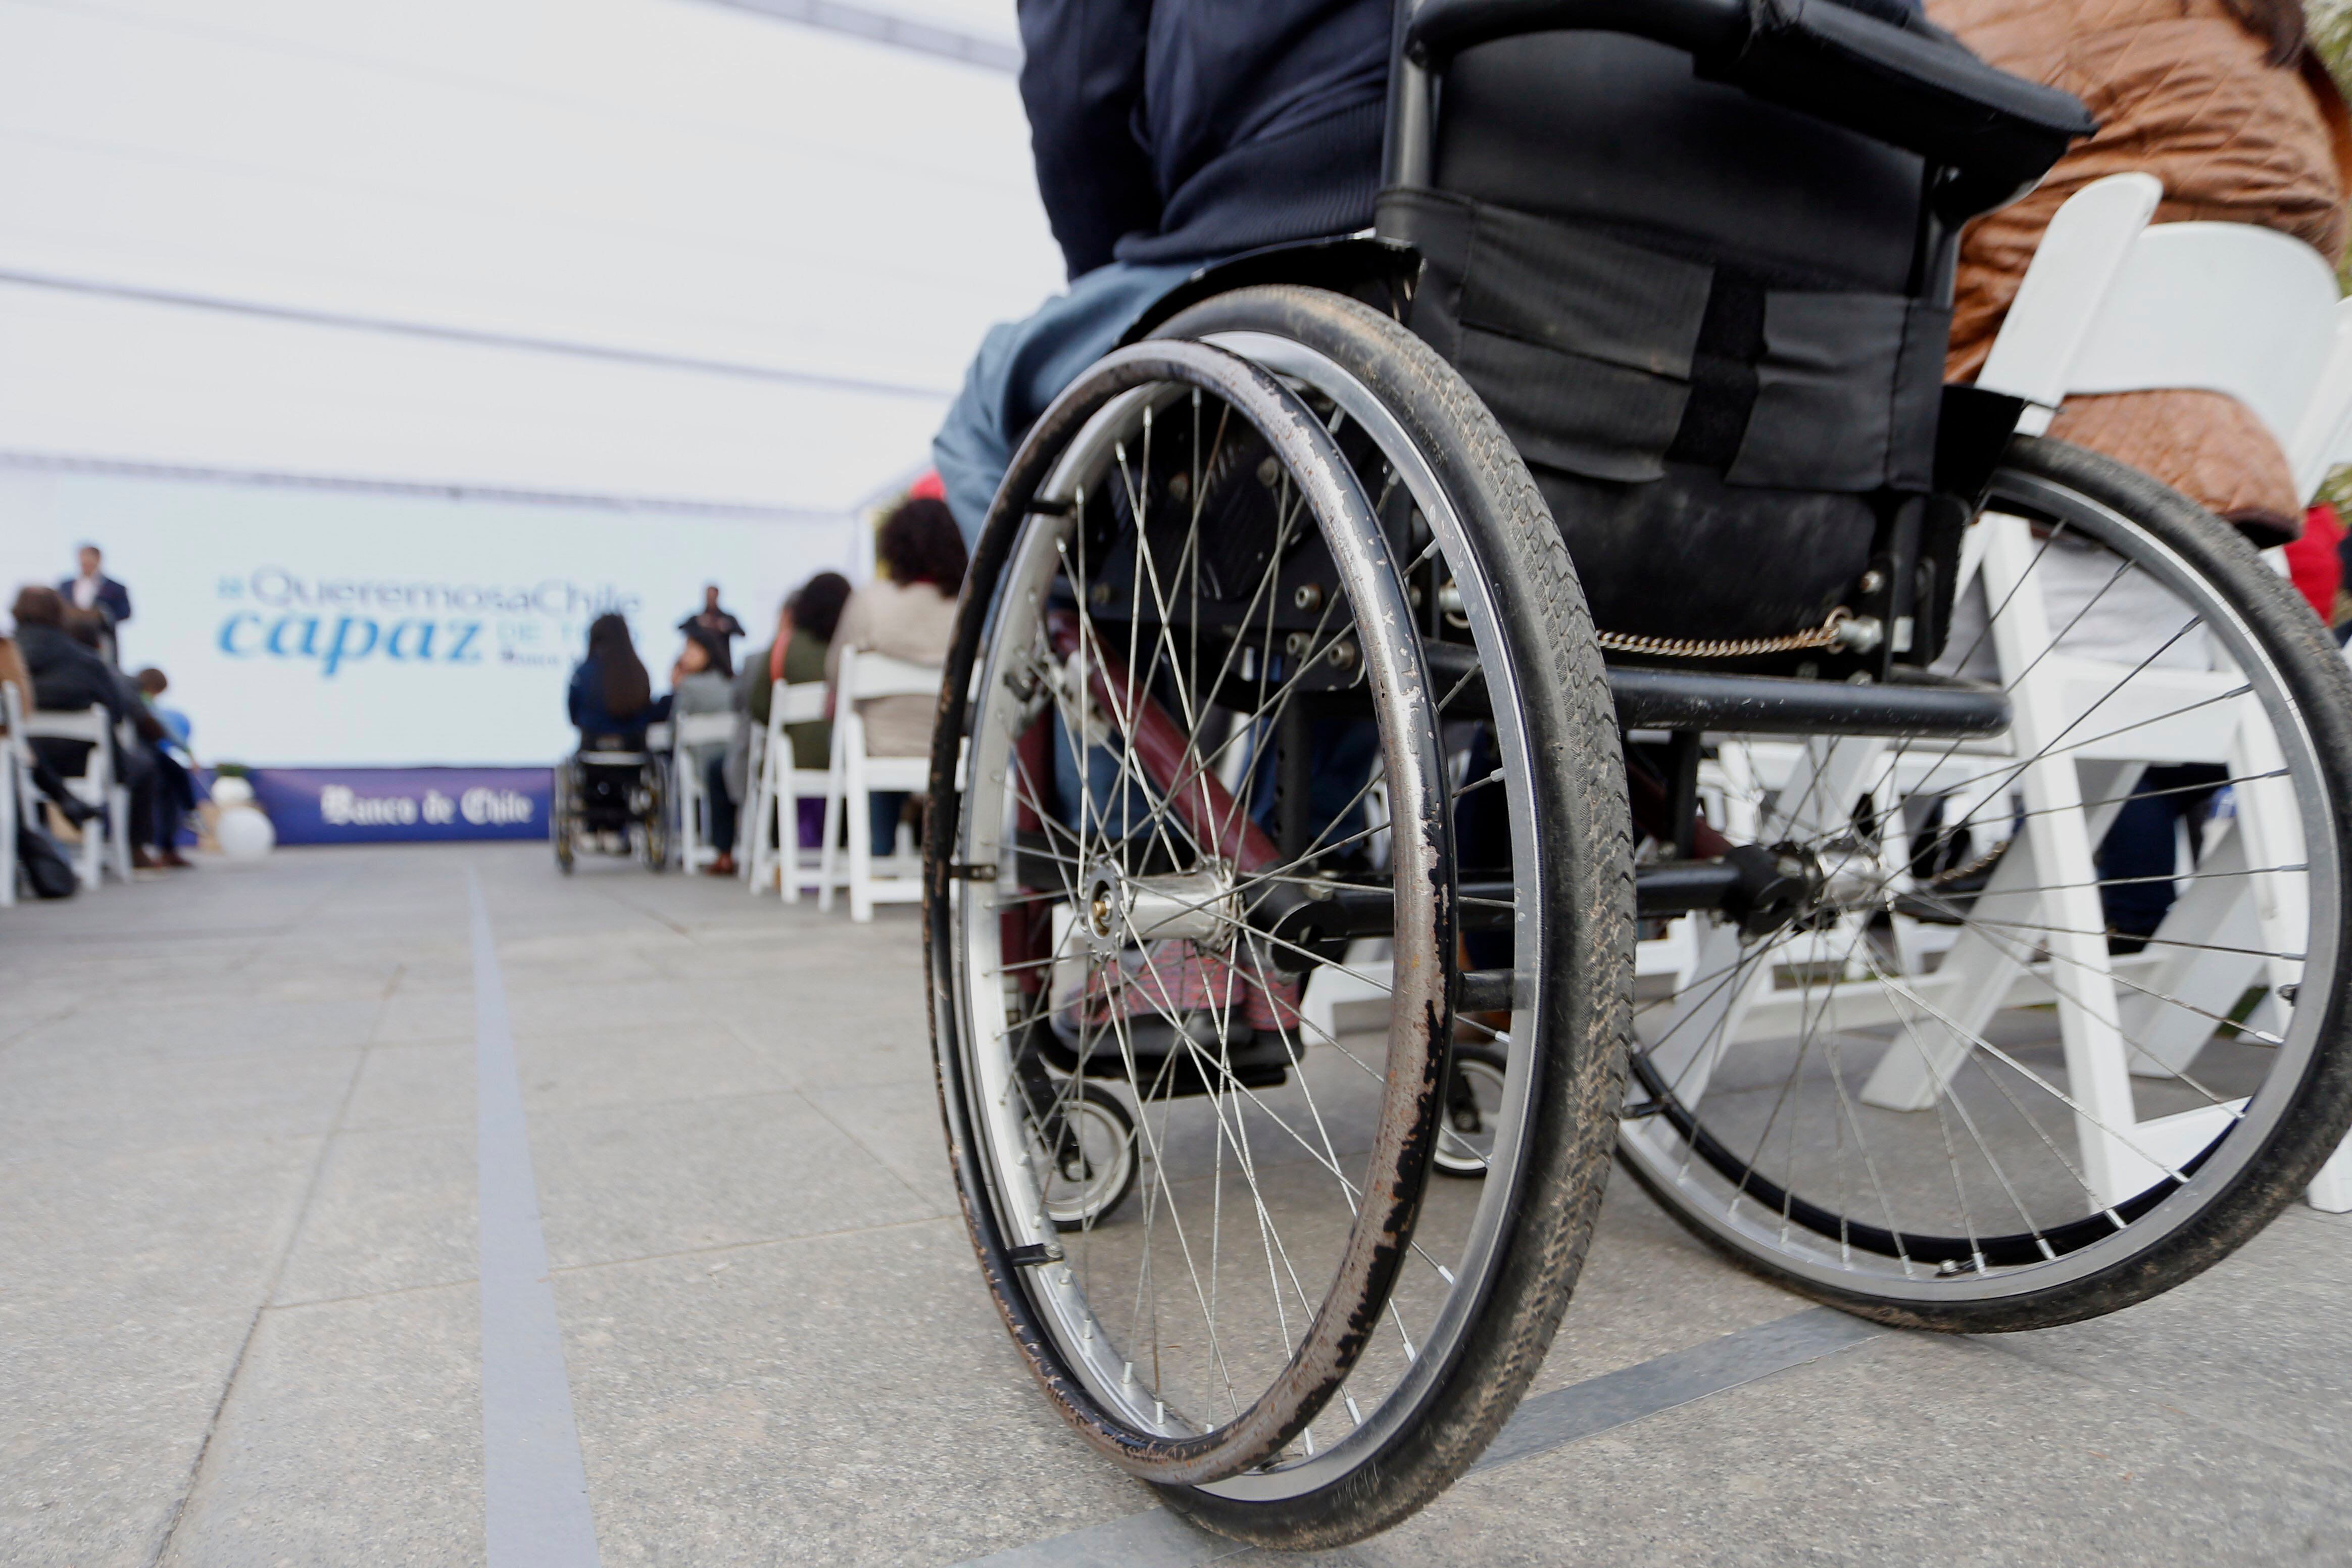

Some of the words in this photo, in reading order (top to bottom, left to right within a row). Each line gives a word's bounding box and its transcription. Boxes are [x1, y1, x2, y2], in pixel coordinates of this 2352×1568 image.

[1430, 442, 1448, 468] PSI
[217, 610, 483, 678] capaz
[422, 789, 453, 824] de
[460, 788, 533, 825] Chile
